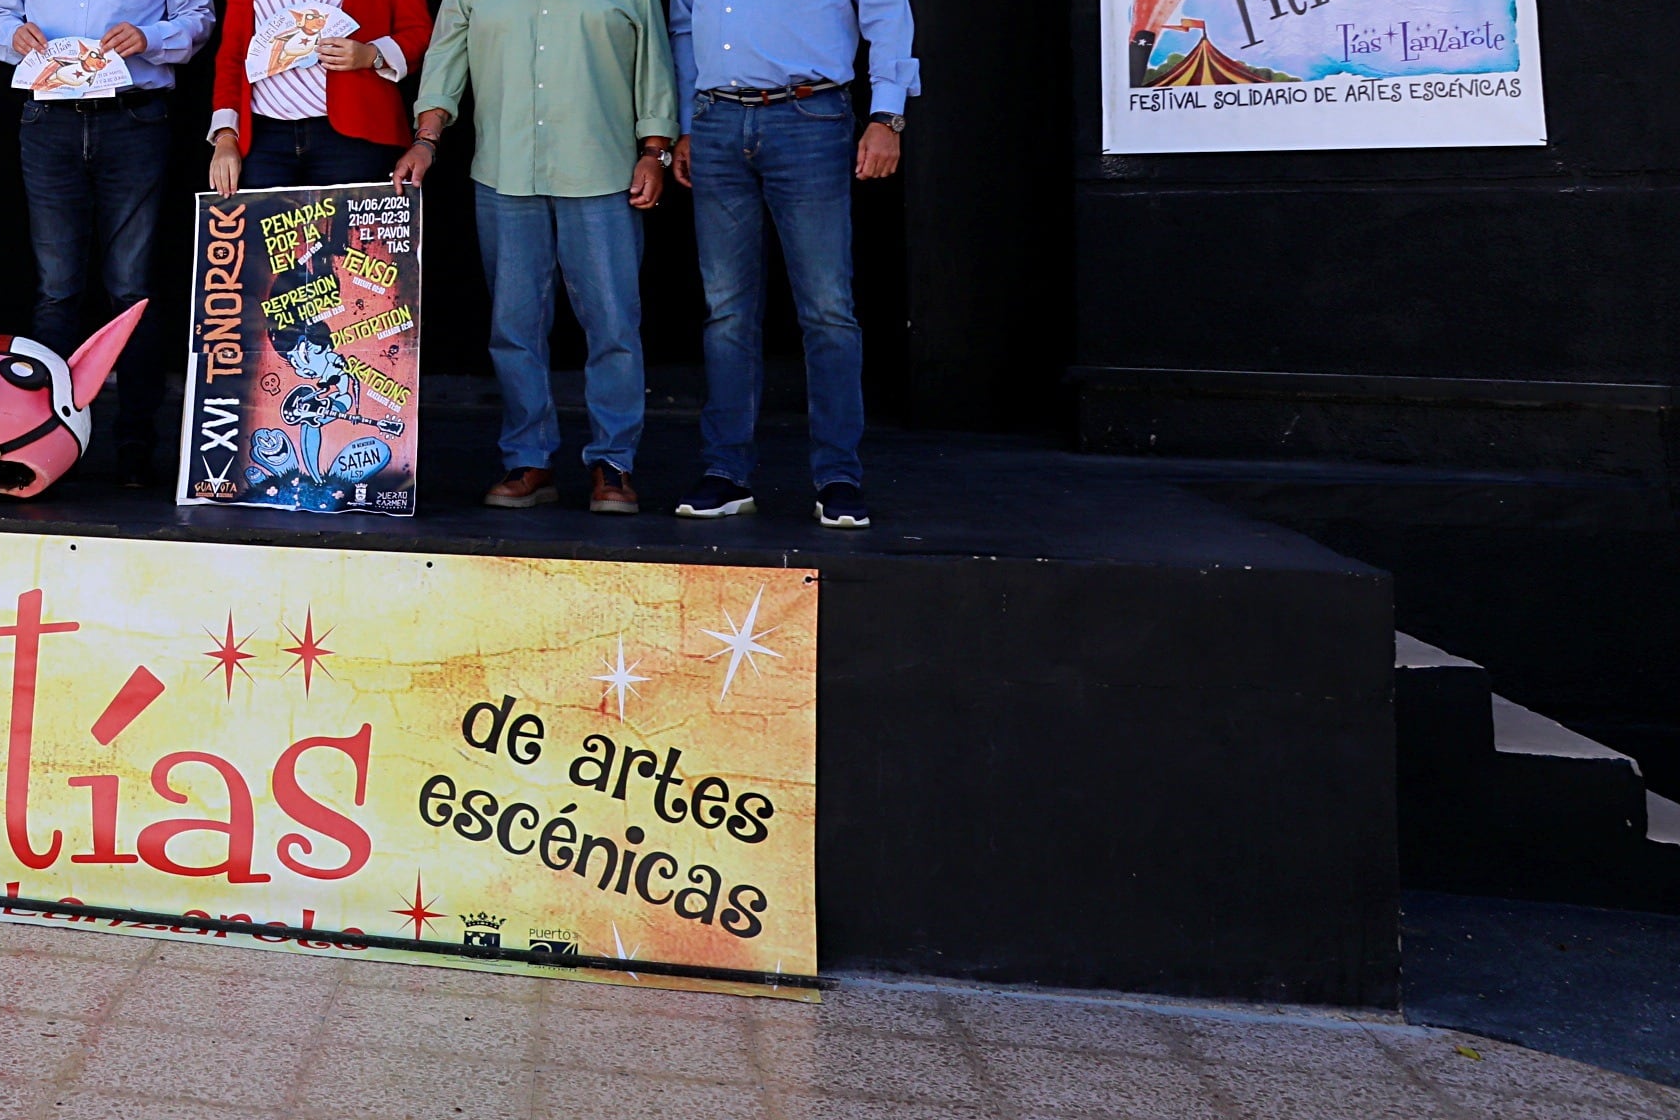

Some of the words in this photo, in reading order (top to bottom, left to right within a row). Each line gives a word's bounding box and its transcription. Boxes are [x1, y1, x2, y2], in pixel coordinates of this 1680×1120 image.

[1399, 20, 1505, 62] Lanzarote
[1315, 86, 1337, 104] DE
[1344, 78, 1401, 102] ARTES
[260, 197, 336, 237] PENADAS
[348, 197, 410, 212] 14/06/2024
[265, 230, 300, 256] POR
[303, 223, 321, 244] LA
[360, 227, 374, 241] EL
[378, 224, 410, 240] PAVÓN
[386, 238, 410, 254] TÍAS
[269, 250, 296, 275] LEY
[261, 274, 338, 317] REPRESIÓN
[275, 311, 295, 331] 24
[297, 291, 342, 321] HORAS
[330, 304, 412, 350] DISTORTION
[343, 356, 411, 406] SKATOONS
[199, 397, 240, 452] XVI
[338, 448, 381, 472] SATAN
[461, 693, 545, 766] de
[568, 733, 775, 844] artes
[420, 774, 768, 939] escénicas
